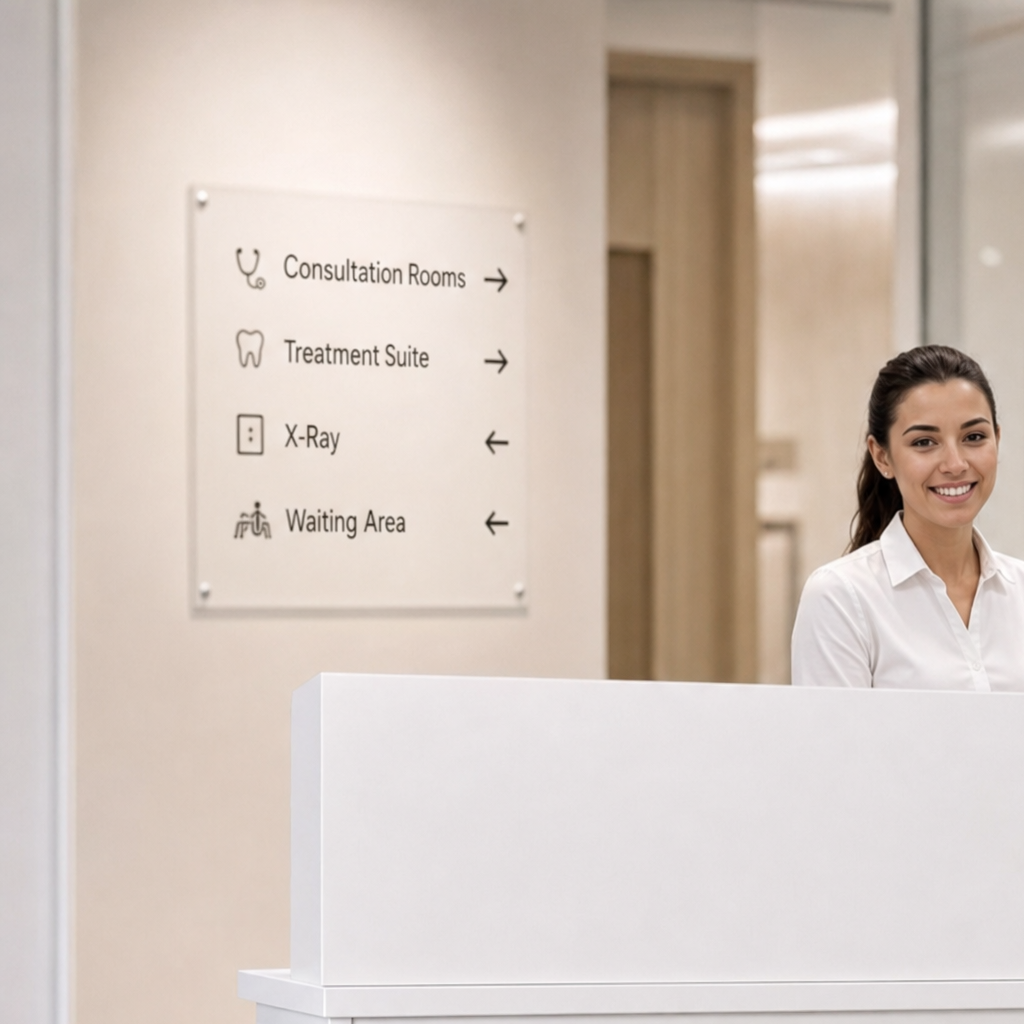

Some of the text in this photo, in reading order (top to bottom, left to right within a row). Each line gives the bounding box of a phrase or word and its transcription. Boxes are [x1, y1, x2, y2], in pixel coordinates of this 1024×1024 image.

[284, 254, 466, 288] Consultation Rooms
[284, 339, 429, 368] Treatment Suite
[285, 424, 340, 455] X-Ray
[286, 509, 405, 539] Waiting Area
